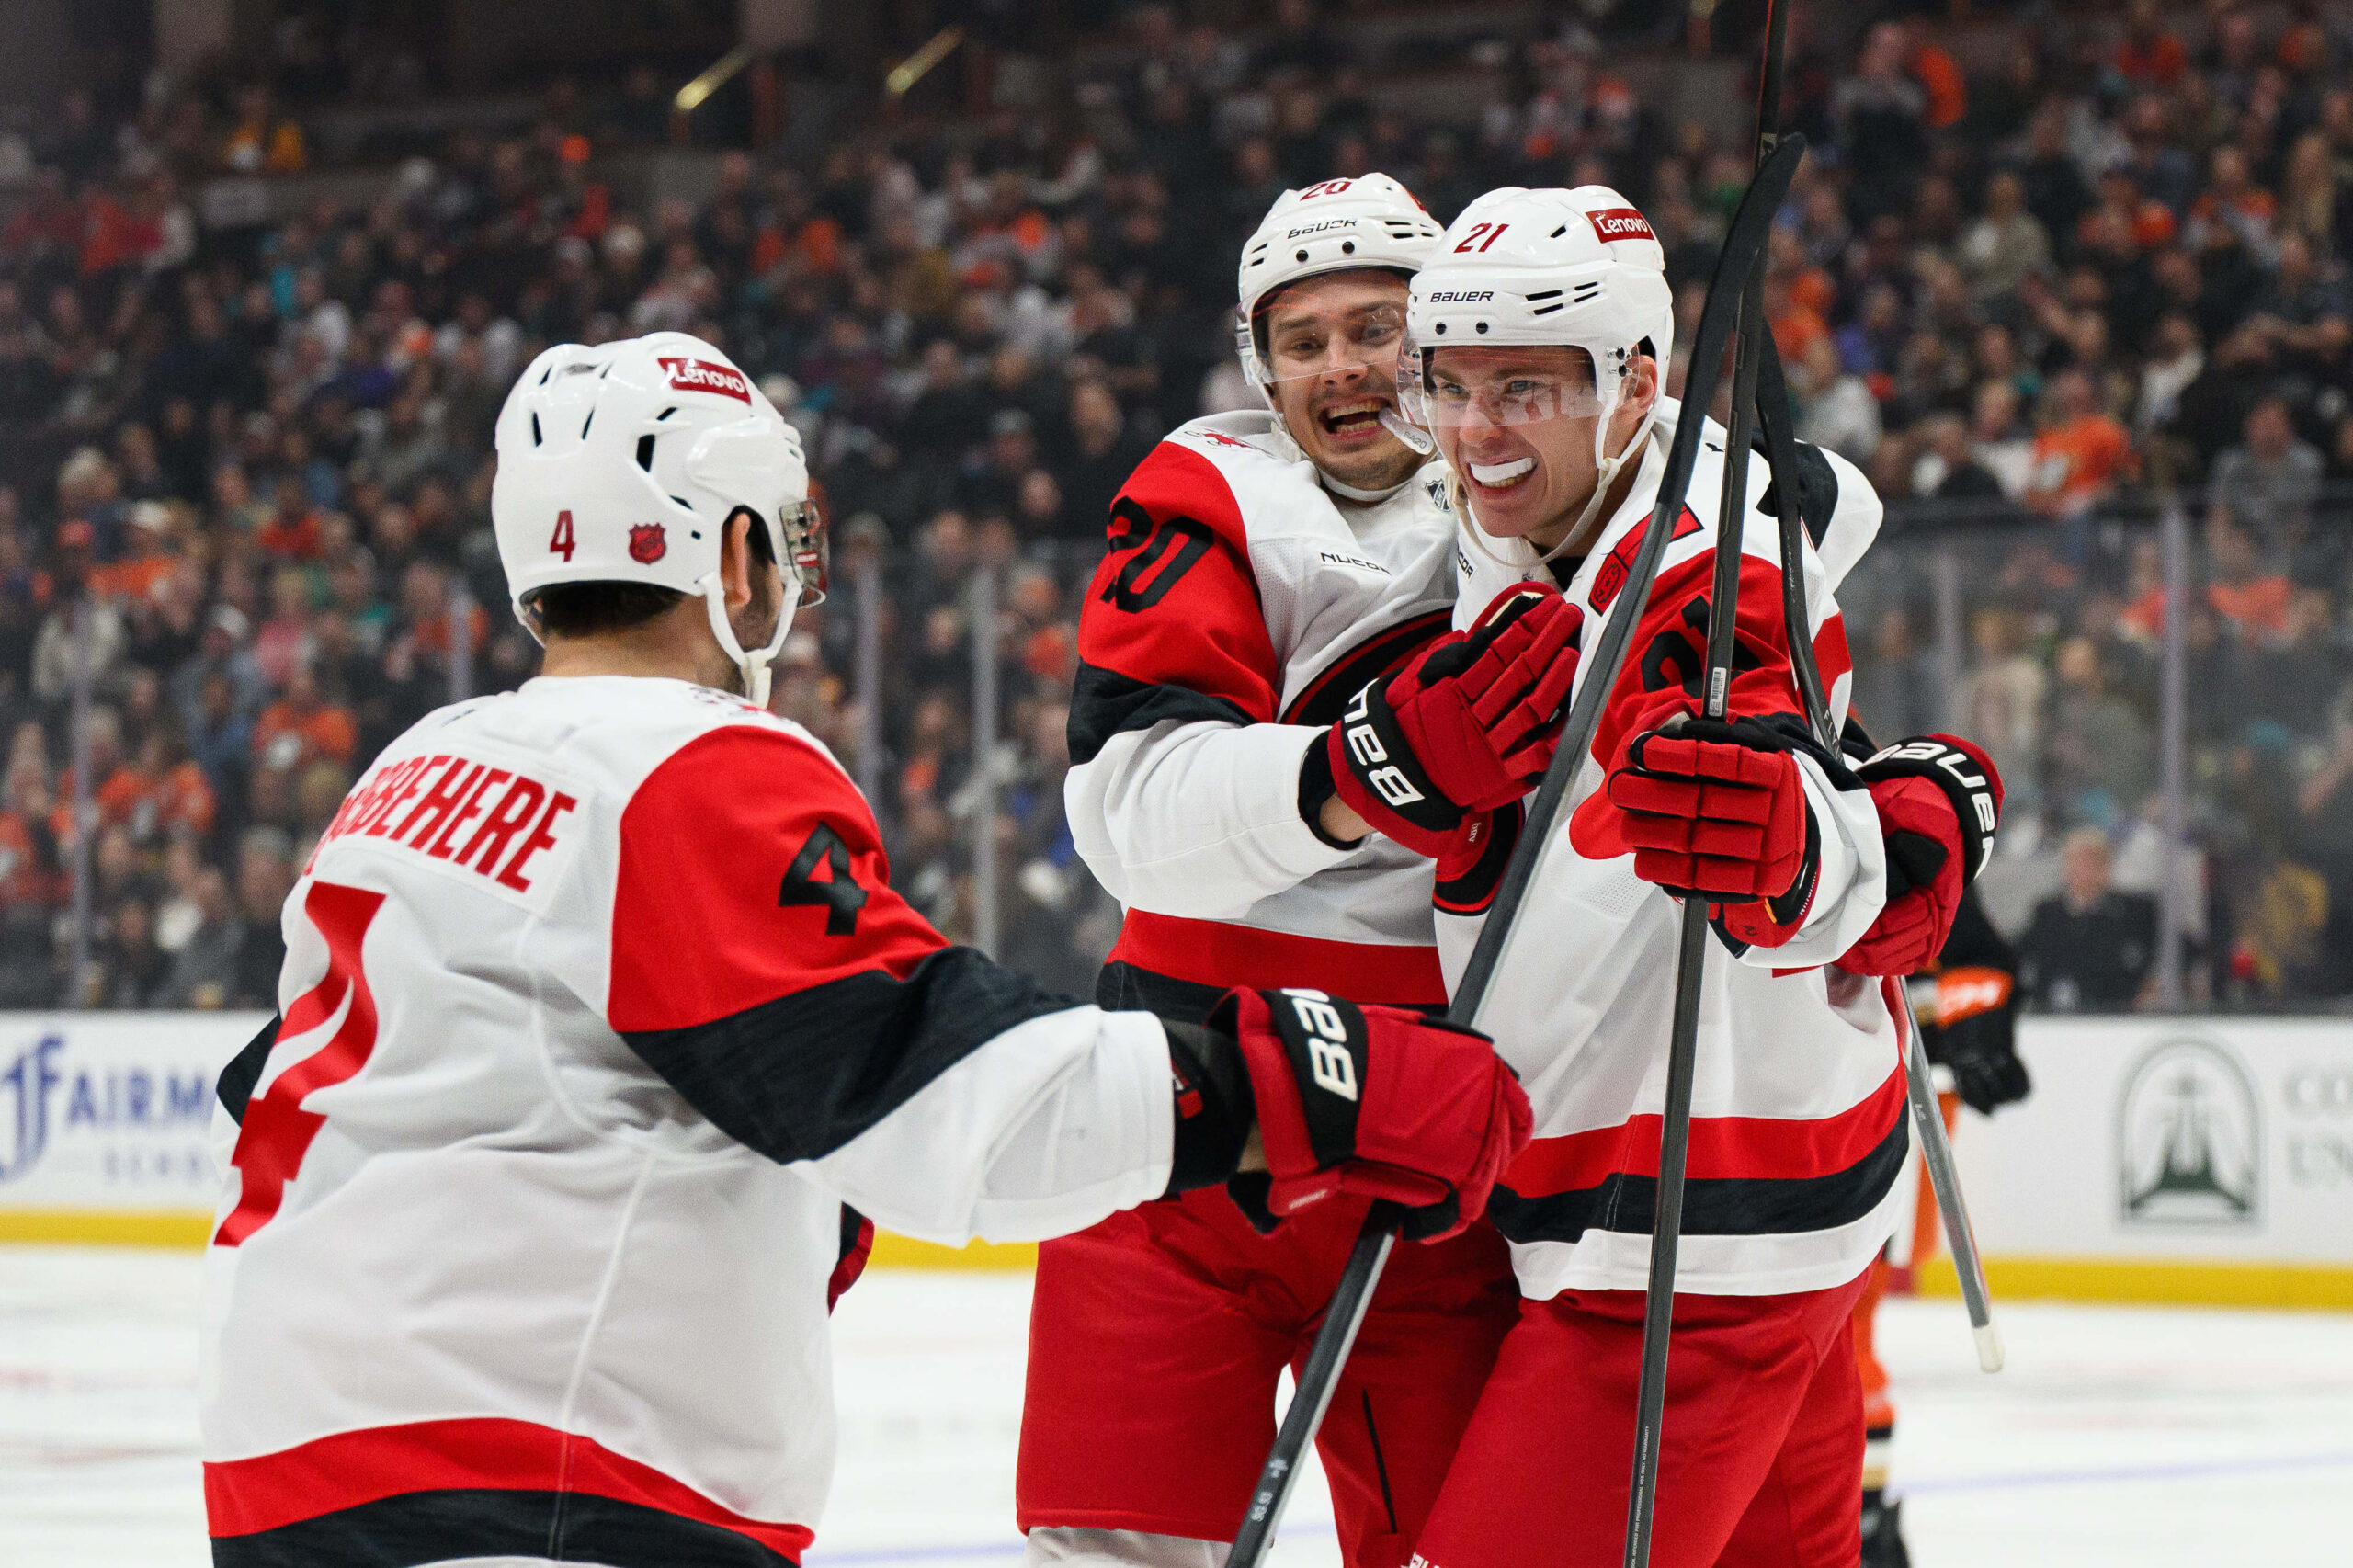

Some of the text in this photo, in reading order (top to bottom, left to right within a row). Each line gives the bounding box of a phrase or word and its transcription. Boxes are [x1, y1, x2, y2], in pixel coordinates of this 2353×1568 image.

[1300, 182, 1352, 202] 20
[1453, 222, 1510, 254] 21
[1594, 212, 1649, 235] Lenovo
[665, 362, 746, 394] Lenovo
[550, 509, 575, 562] 4
[1099, 495, 1214, 614] 20
[779, 820, 869, 936] 4
[213, 880, 387, 1248] 4
